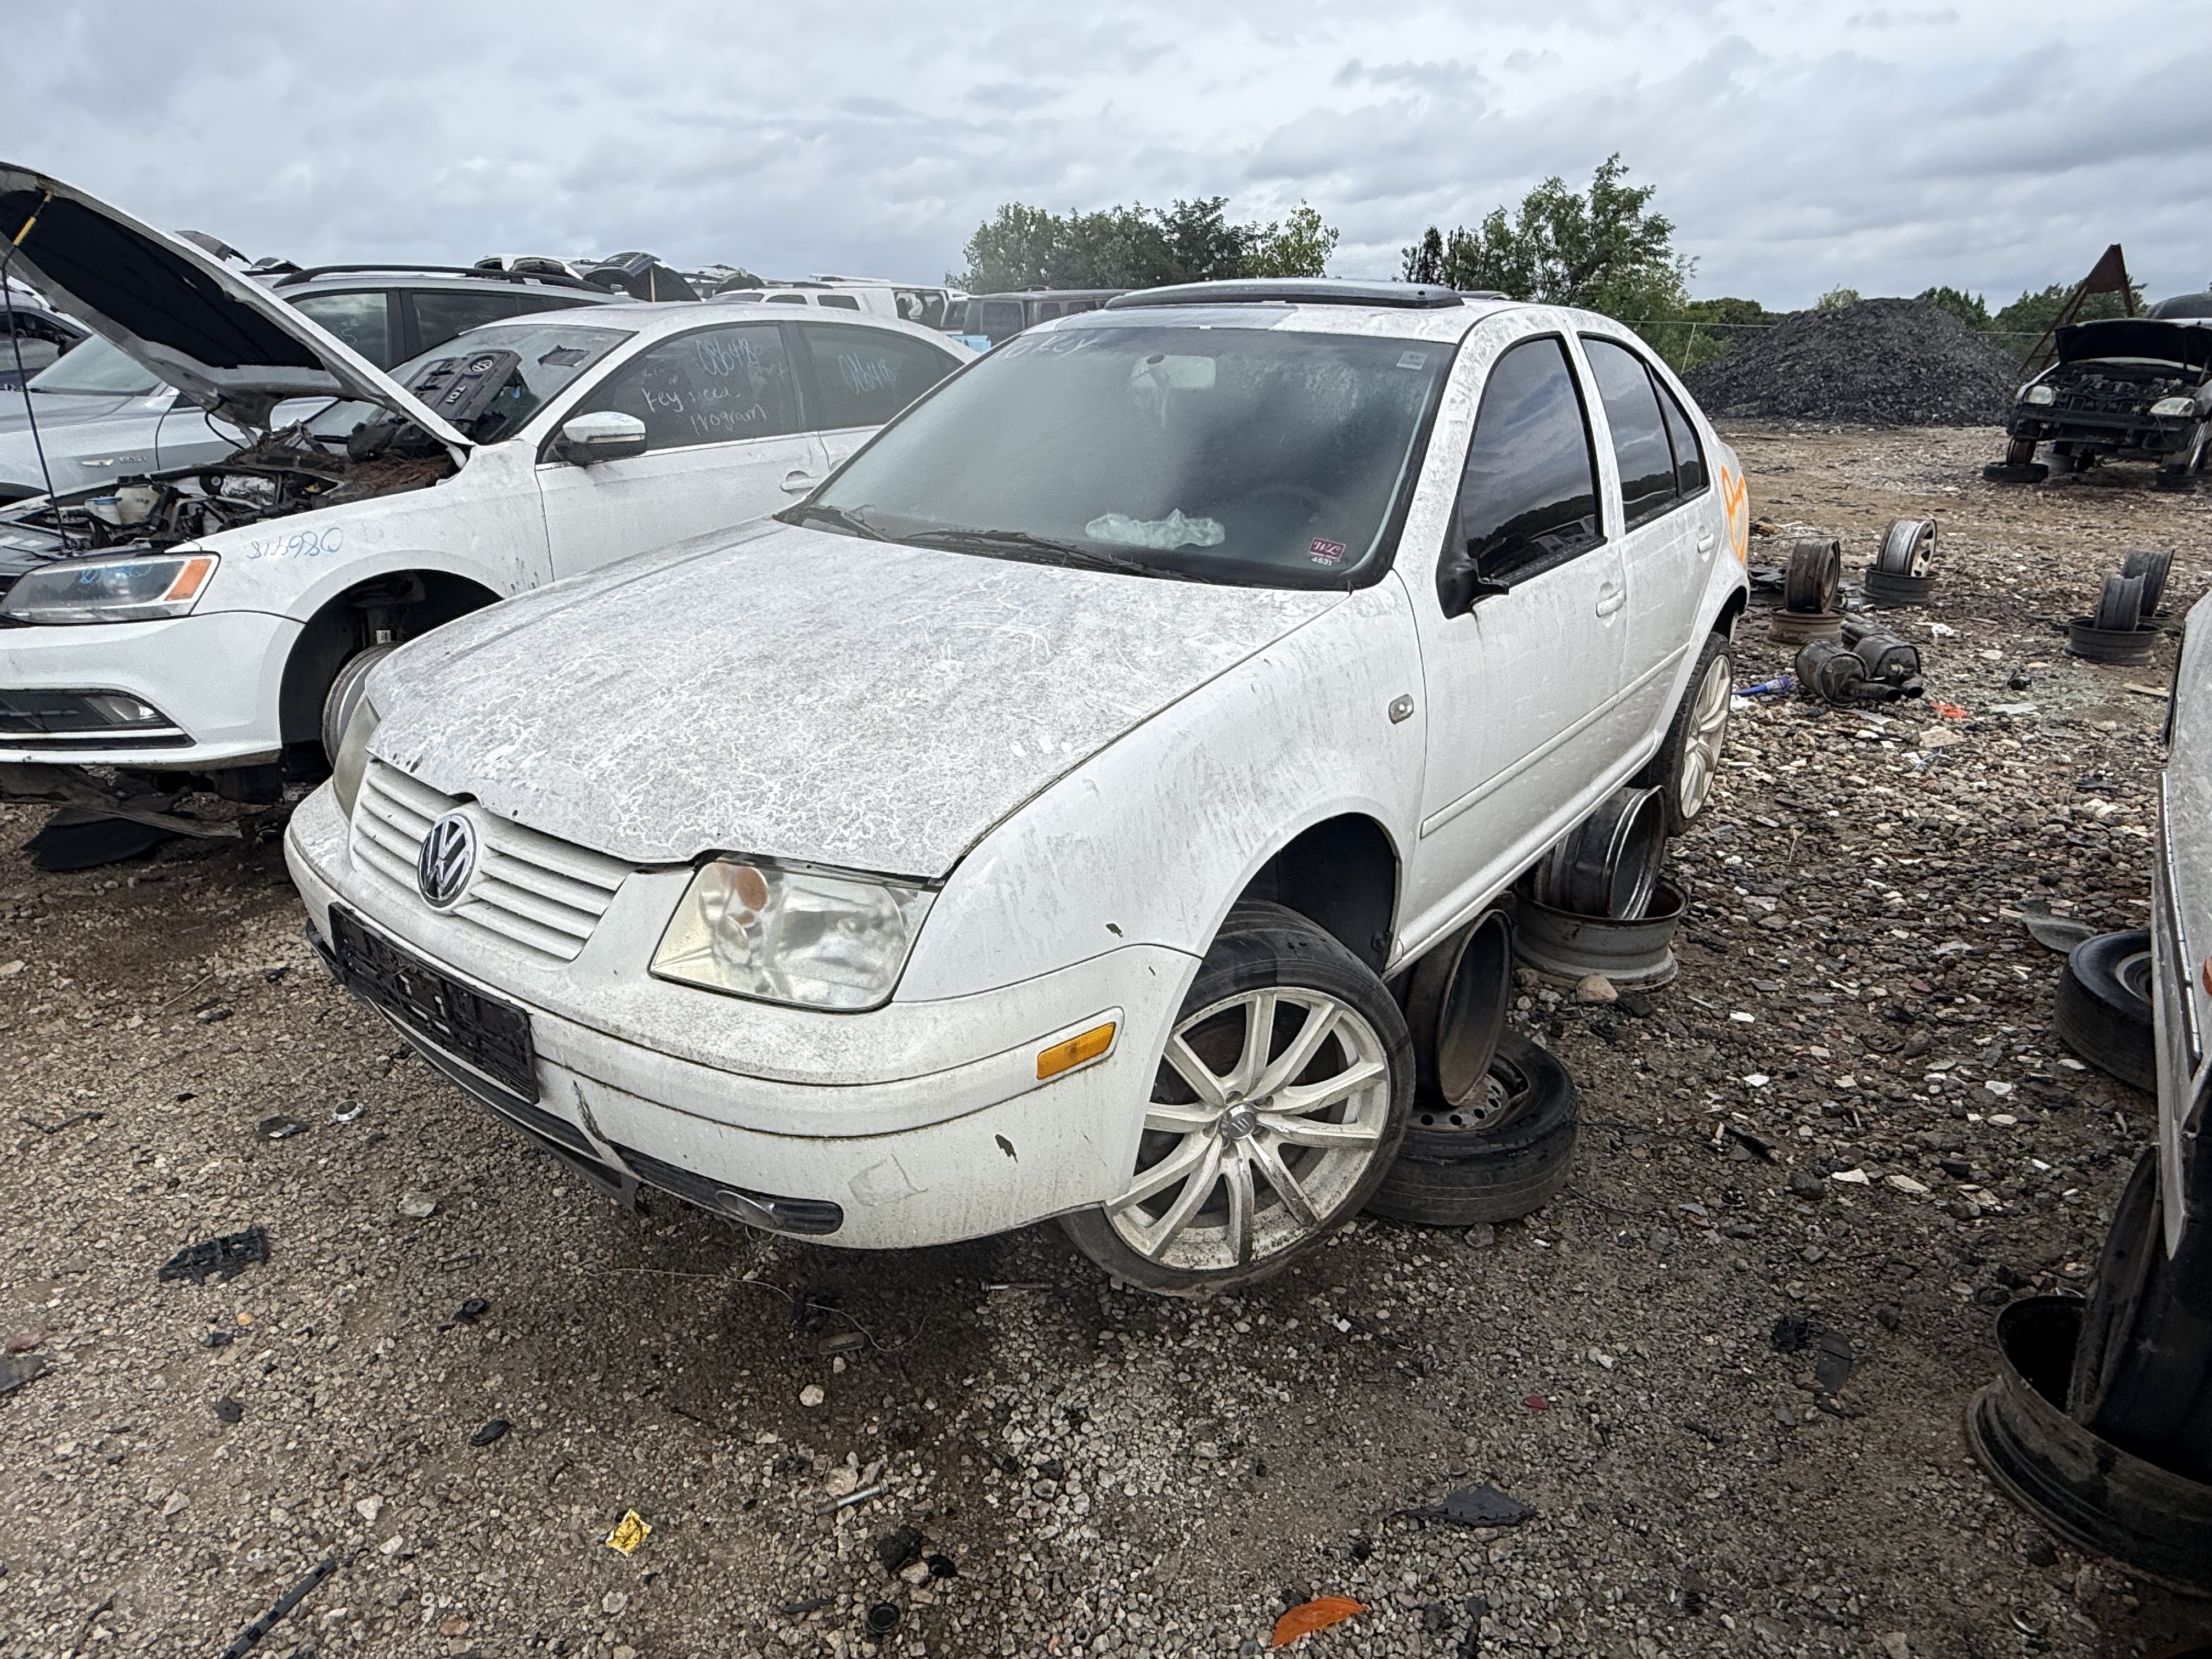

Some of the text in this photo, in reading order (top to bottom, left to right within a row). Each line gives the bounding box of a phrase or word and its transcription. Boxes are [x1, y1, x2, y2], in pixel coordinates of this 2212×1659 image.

[696, 337, 759, 376] 086418
[445, 385, 467, 404] TDI
[419, 815, 476, 905] VW
